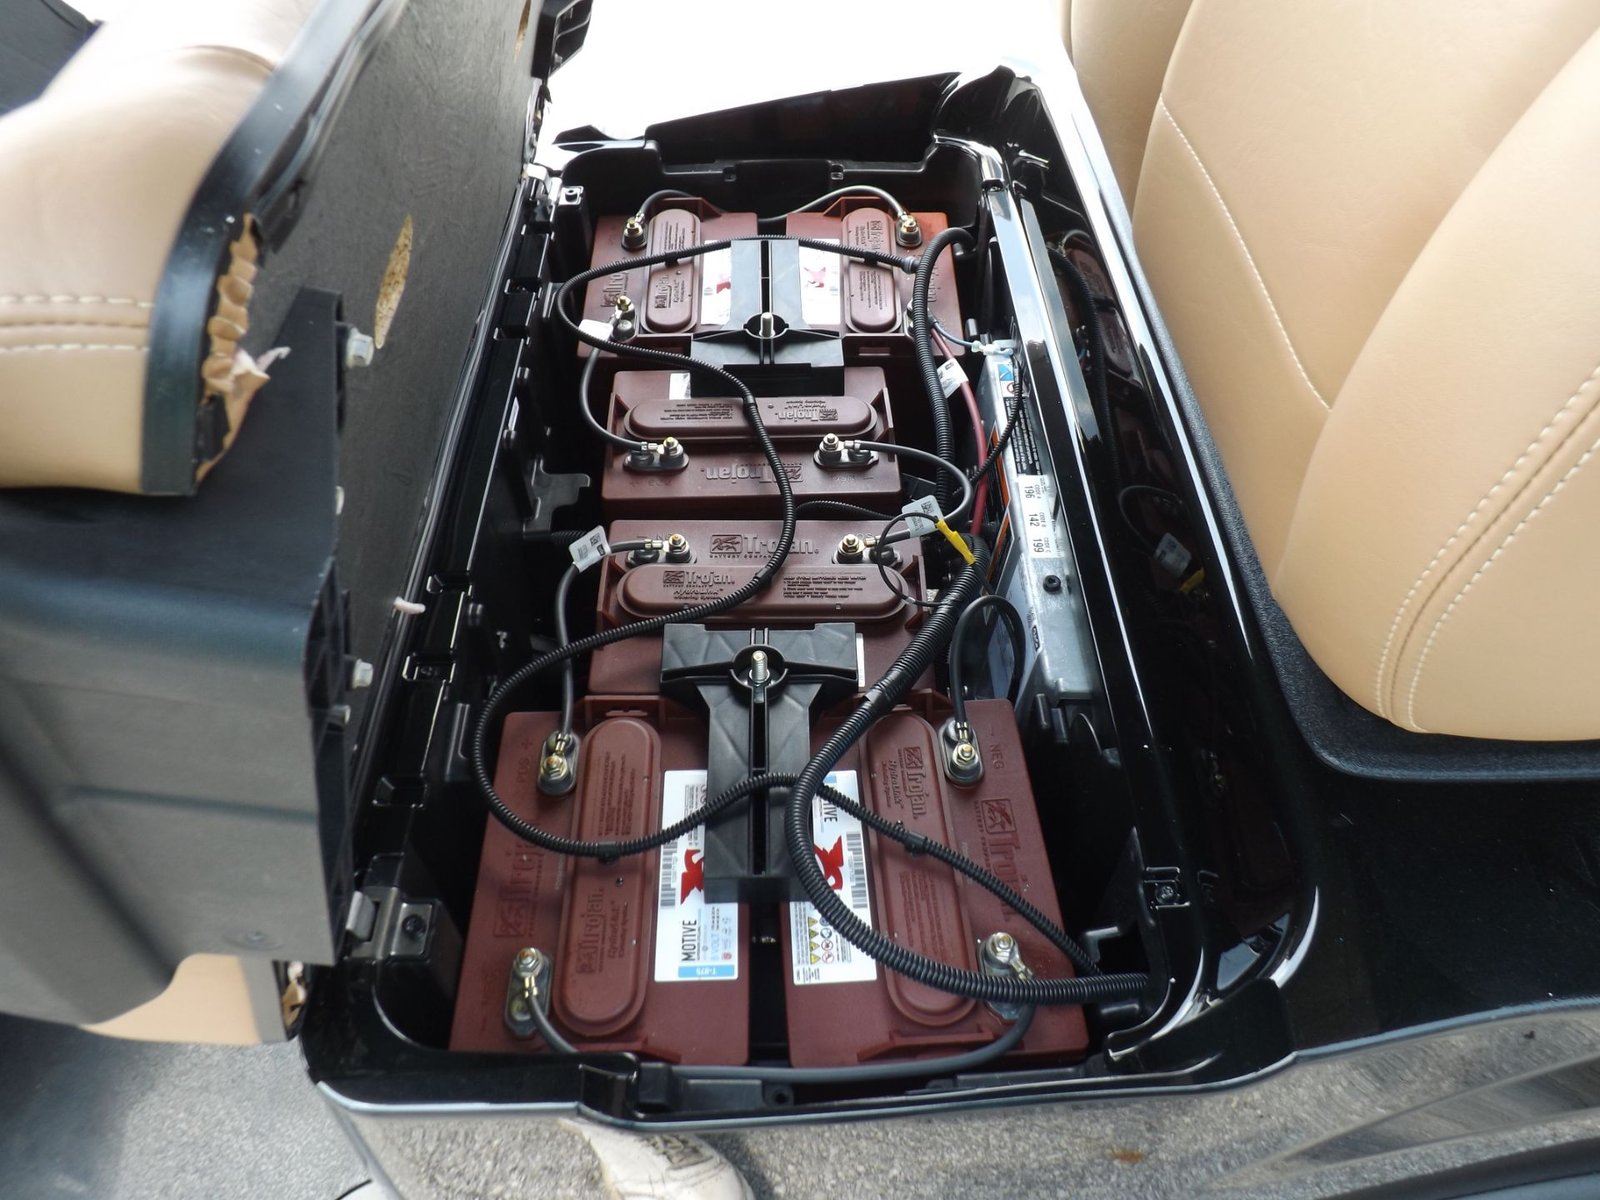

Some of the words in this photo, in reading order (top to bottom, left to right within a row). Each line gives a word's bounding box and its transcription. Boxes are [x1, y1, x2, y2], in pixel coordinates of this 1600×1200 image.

[777, 408, 819, 422] Trojan
[705, 464, 773, 484] Trojan
[1024, 486, 1035, 499] 196
[1029, 514, 1040, 527] 142
[743, 534, 814, 554] Troan
[1033, 539, 1044, 553] 199
[686, 571, 732, 587] Trojan
[990, 744, 1004, 770] NEG
[517, 757, 530, 783] POS
[906, 770, 929, 816] Trojan
[824, 800, 838, 822] TIVE
[577, 893, 607, 949] Trojan
[681, 920, 697, 961] MOTIVE
